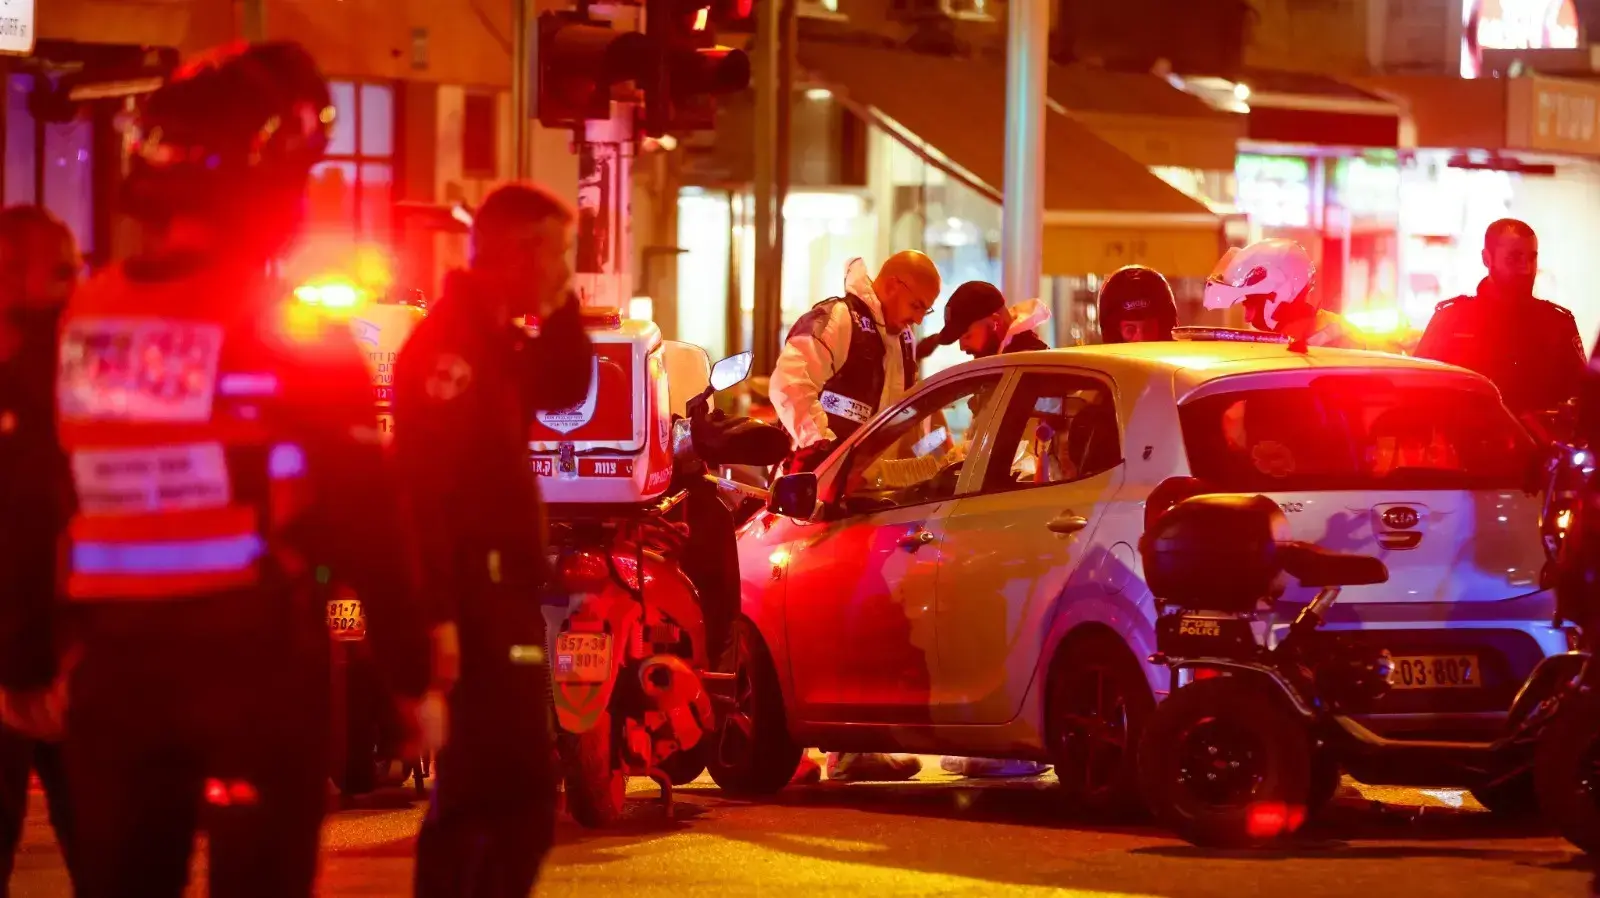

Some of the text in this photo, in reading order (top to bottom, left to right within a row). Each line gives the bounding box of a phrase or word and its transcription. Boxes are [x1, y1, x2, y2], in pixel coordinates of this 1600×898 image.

[532, 461, 551, 475] ק.או
[594, 461, 617, 474] צוות
[1180, 626, 1220, 636] POLICE
